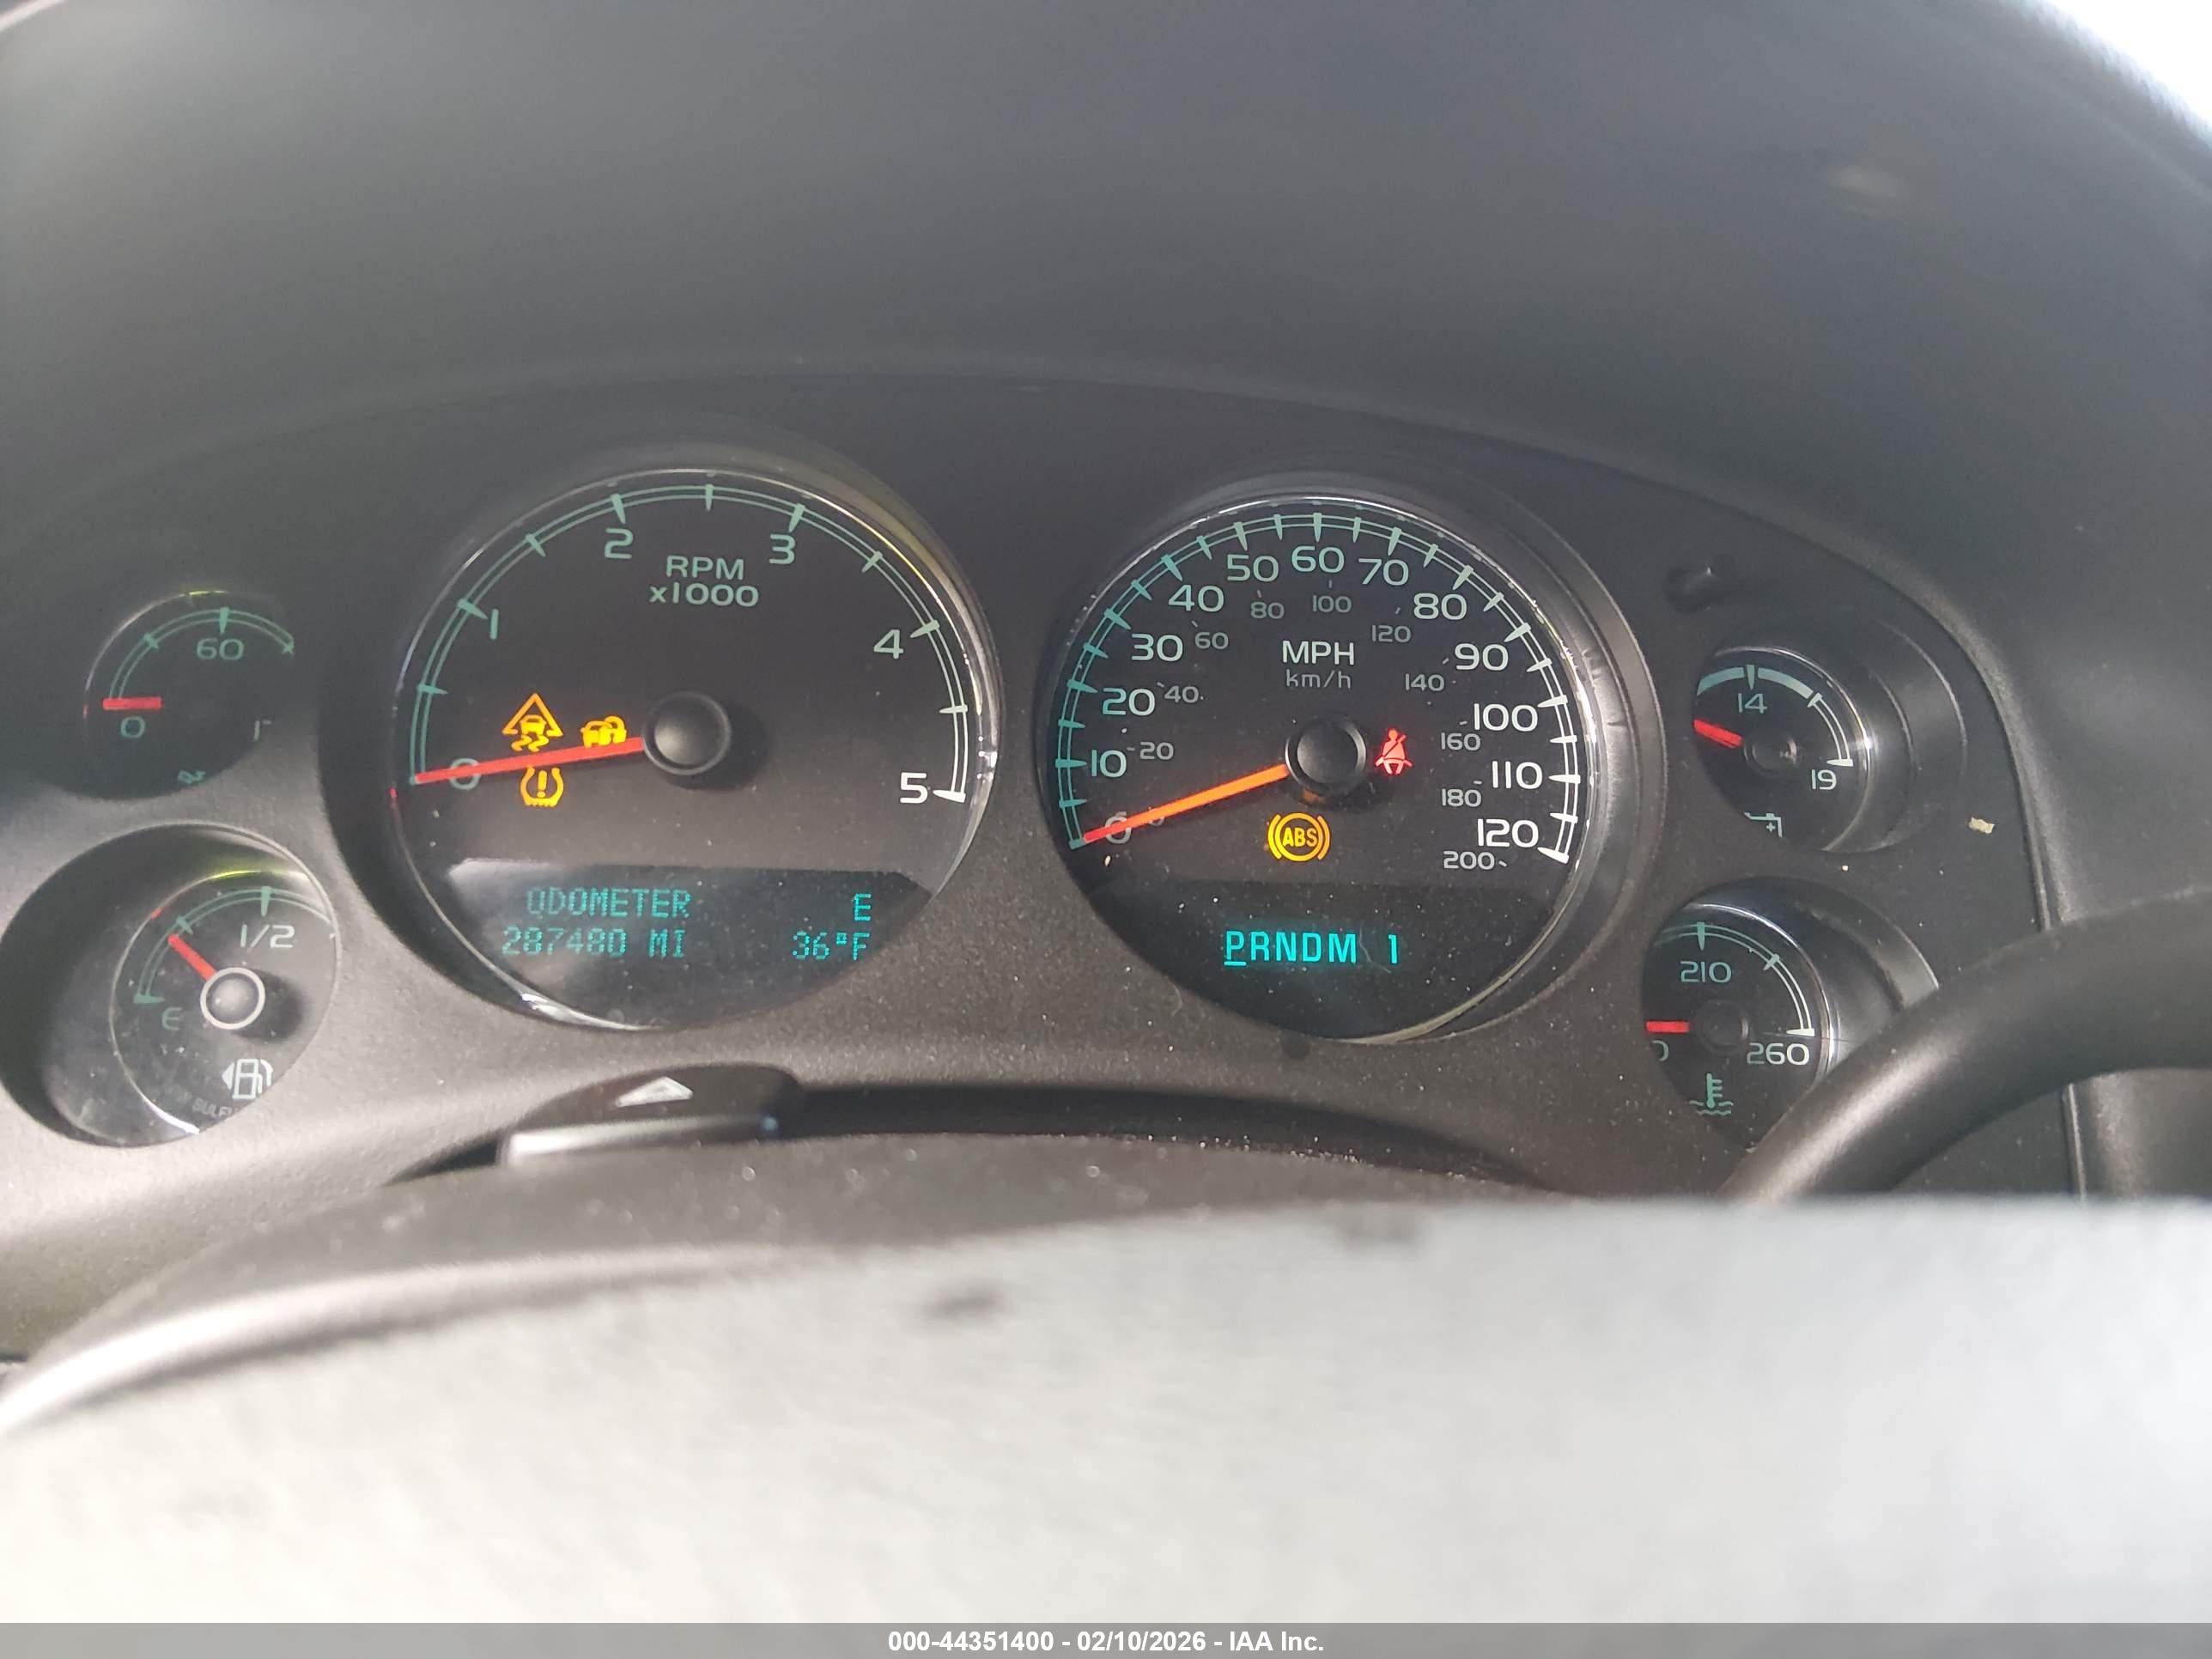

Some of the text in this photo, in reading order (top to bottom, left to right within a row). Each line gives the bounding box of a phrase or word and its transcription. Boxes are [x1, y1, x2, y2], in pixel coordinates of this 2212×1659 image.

[604, 527, 634, 559] 2
[769, 533, 797, 565] 3
[665, 556, 745, 581] RPM
[1227, 554, 1279, 582] 50
[1291, 545, 1345, 573] 60
[1358, 557, 1409, 586] 70
[649, 581, 759, 607] x1000
[1168, 584, 1224, 612] 40
[1312, 594, 1352, 613] 100
[1413, 592, 1468, 620] 80
[1250, 601, 1285, 619] 80
[489, 608, 499, 640] 1
[1371, 624, 1412, 643] 120
[196, 637, 245, 660] 60
[873, 629, 904, 659] 4
[1131, 633, 1183, 662] 30
[1194, 631, 1229, 650] 60
[1282, 640, 1354, 665] MPH
[1455, 642, 1509, 671] 90
[1285, 668, 1351, 690] km/h
[1405, 673, 1445, 691] 140
[1102, 687, 1156, 716] 20
[1164, 685, 1199, 704] 40
[1737, 692, 1768, 714] 14
[119, 715, 146, 738] 0
[1474, 703, 1538, 732] 100
[1139, 741, 1174, 760] 20
[1441, 732, 1481, 751] 160
[449, 758, 481, 790] 0
[1091, 749, 1127, 778] 10
[1492, 760, 1543, 790] 110
[899, 772, 928, 804] 5
[1811, 769, 1837, 791] 19
[1442, 788, 1482, 807] 180
[1282, 827, 1318, 848] ABS
[1477, 818, 1540, 848] 120
[1443, 850, 1495, 870] 200
[526, 886, 692, 918] ODOMETER
[854, 893, 872, 921] E
[240, 923, 296, 950] 1/2
[501, 925, 685, 957] 287480 MI
[1224, 930, 1398, 966] PRNDM 1
[1680, 960, 1732, 983] 210
[161, 1006, 180, 1031] E
[1746, 1042, 1810, 1066] 260
